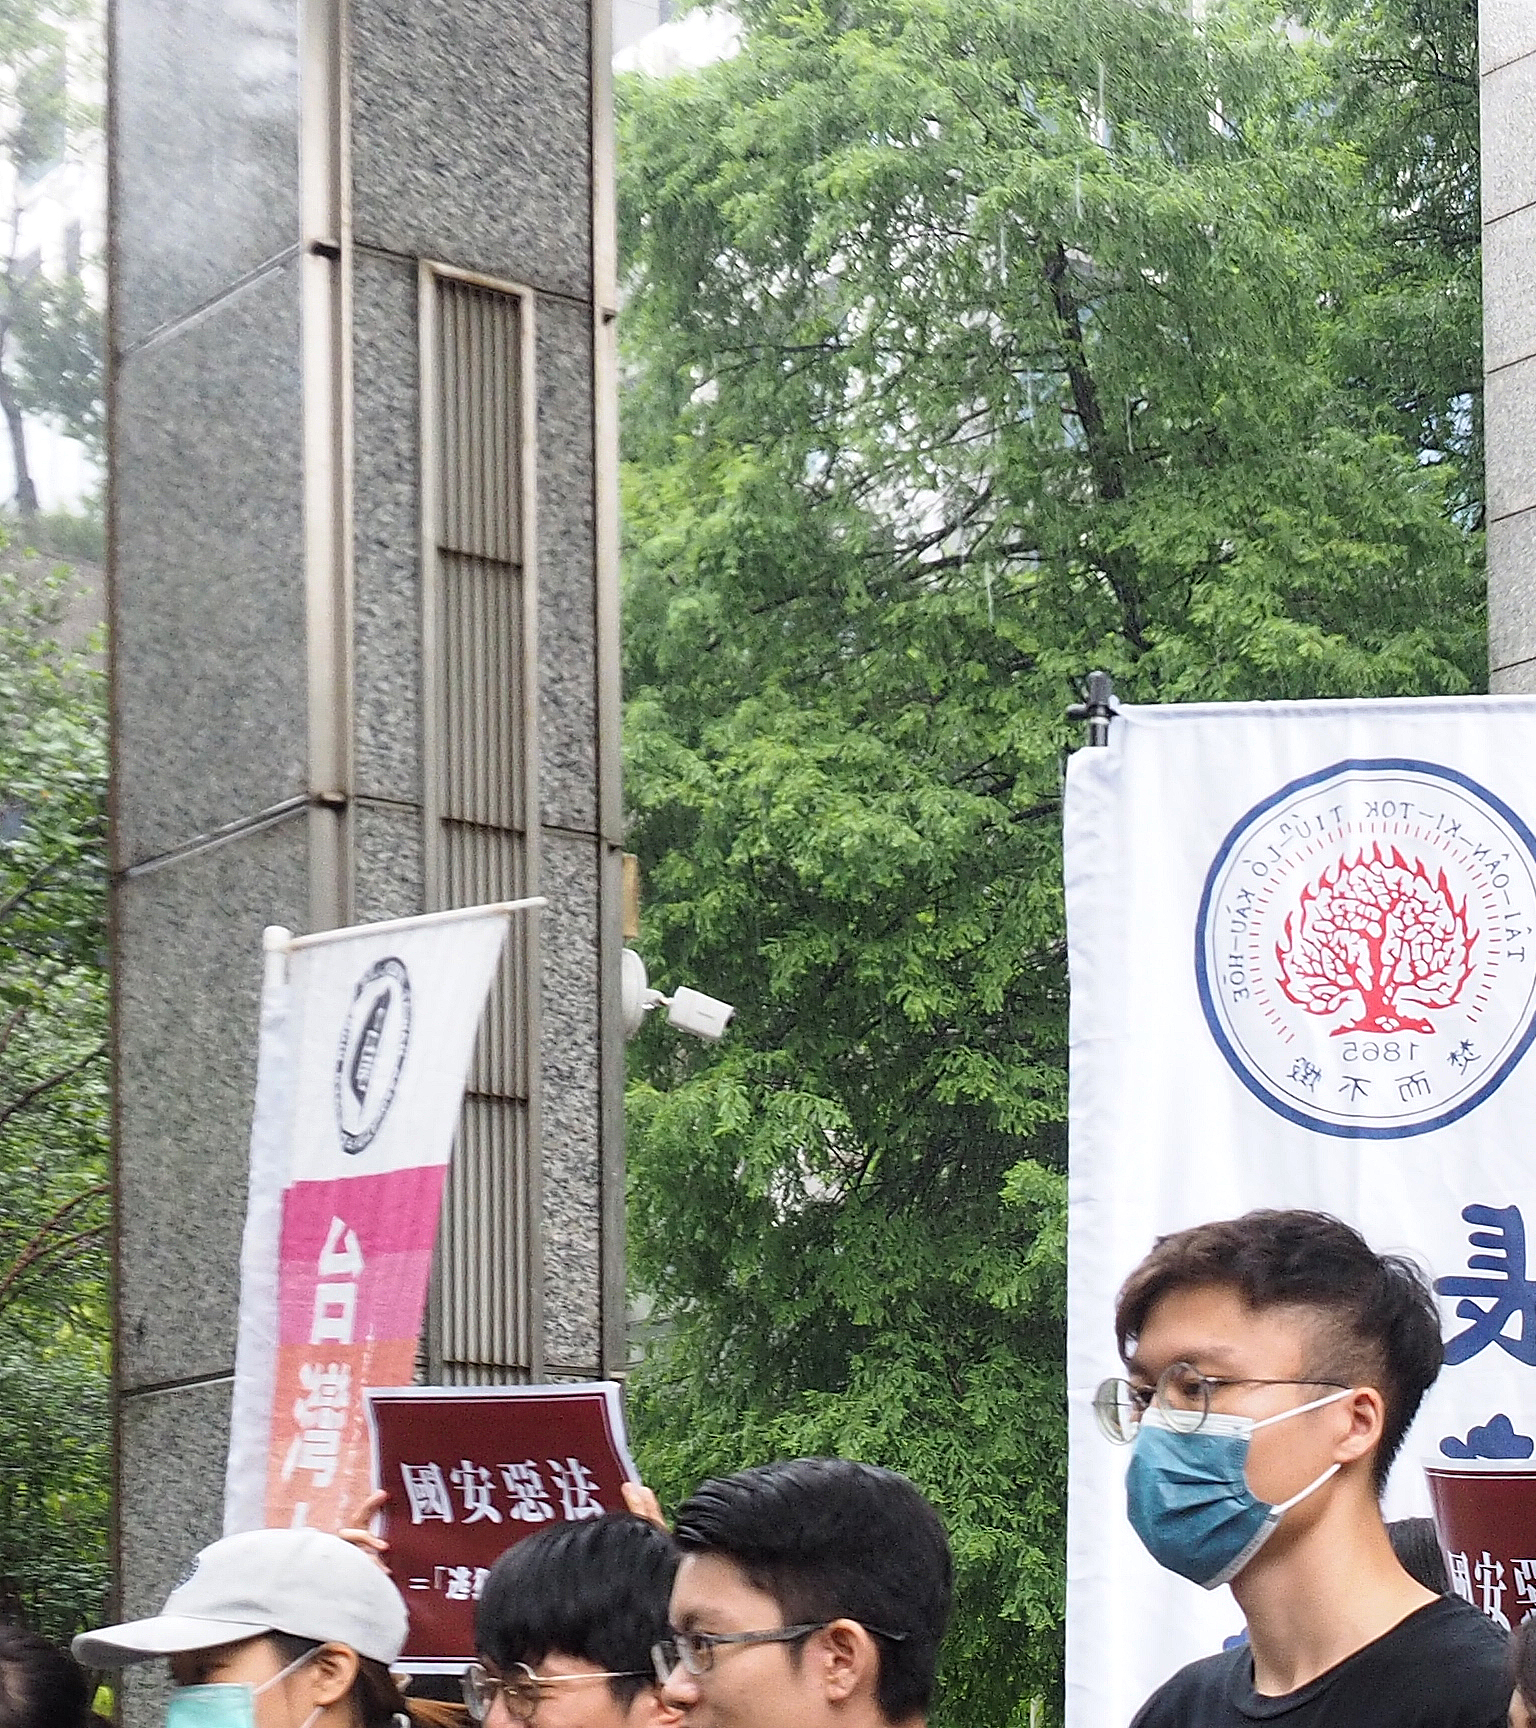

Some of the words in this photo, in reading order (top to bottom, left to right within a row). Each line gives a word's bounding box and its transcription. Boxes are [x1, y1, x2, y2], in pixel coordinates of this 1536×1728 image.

[281, 1214, 365, 1528] 台灣
[400, 1457, 606, 1525] 國安惡法
